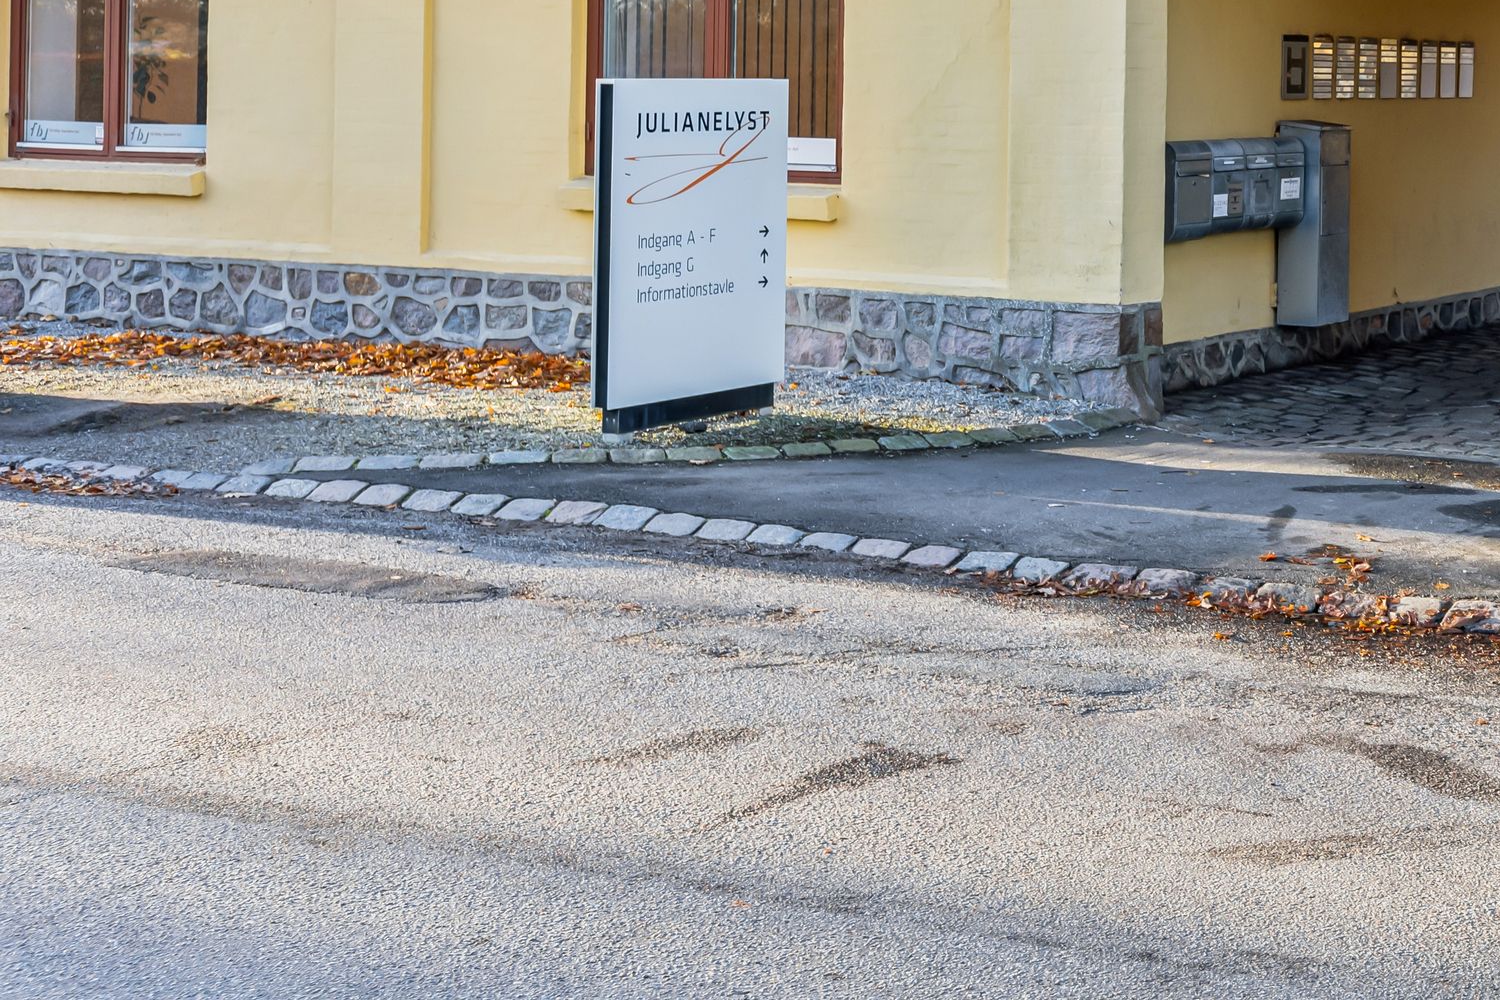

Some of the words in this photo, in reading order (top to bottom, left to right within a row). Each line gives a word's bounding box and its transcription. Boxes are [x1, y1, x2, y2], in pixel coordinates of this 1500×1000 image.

[636, 110, 770, 139] JULIANELYST
[638, 233, 682, 252] Indgang
[687, 230, 696, 245] A
[709, 228, 716, 243] F
[637, 260, 682, 279] Indgang
[686, 257, 694, 272] G
[637, 278, 735, 303] Informationstavle
